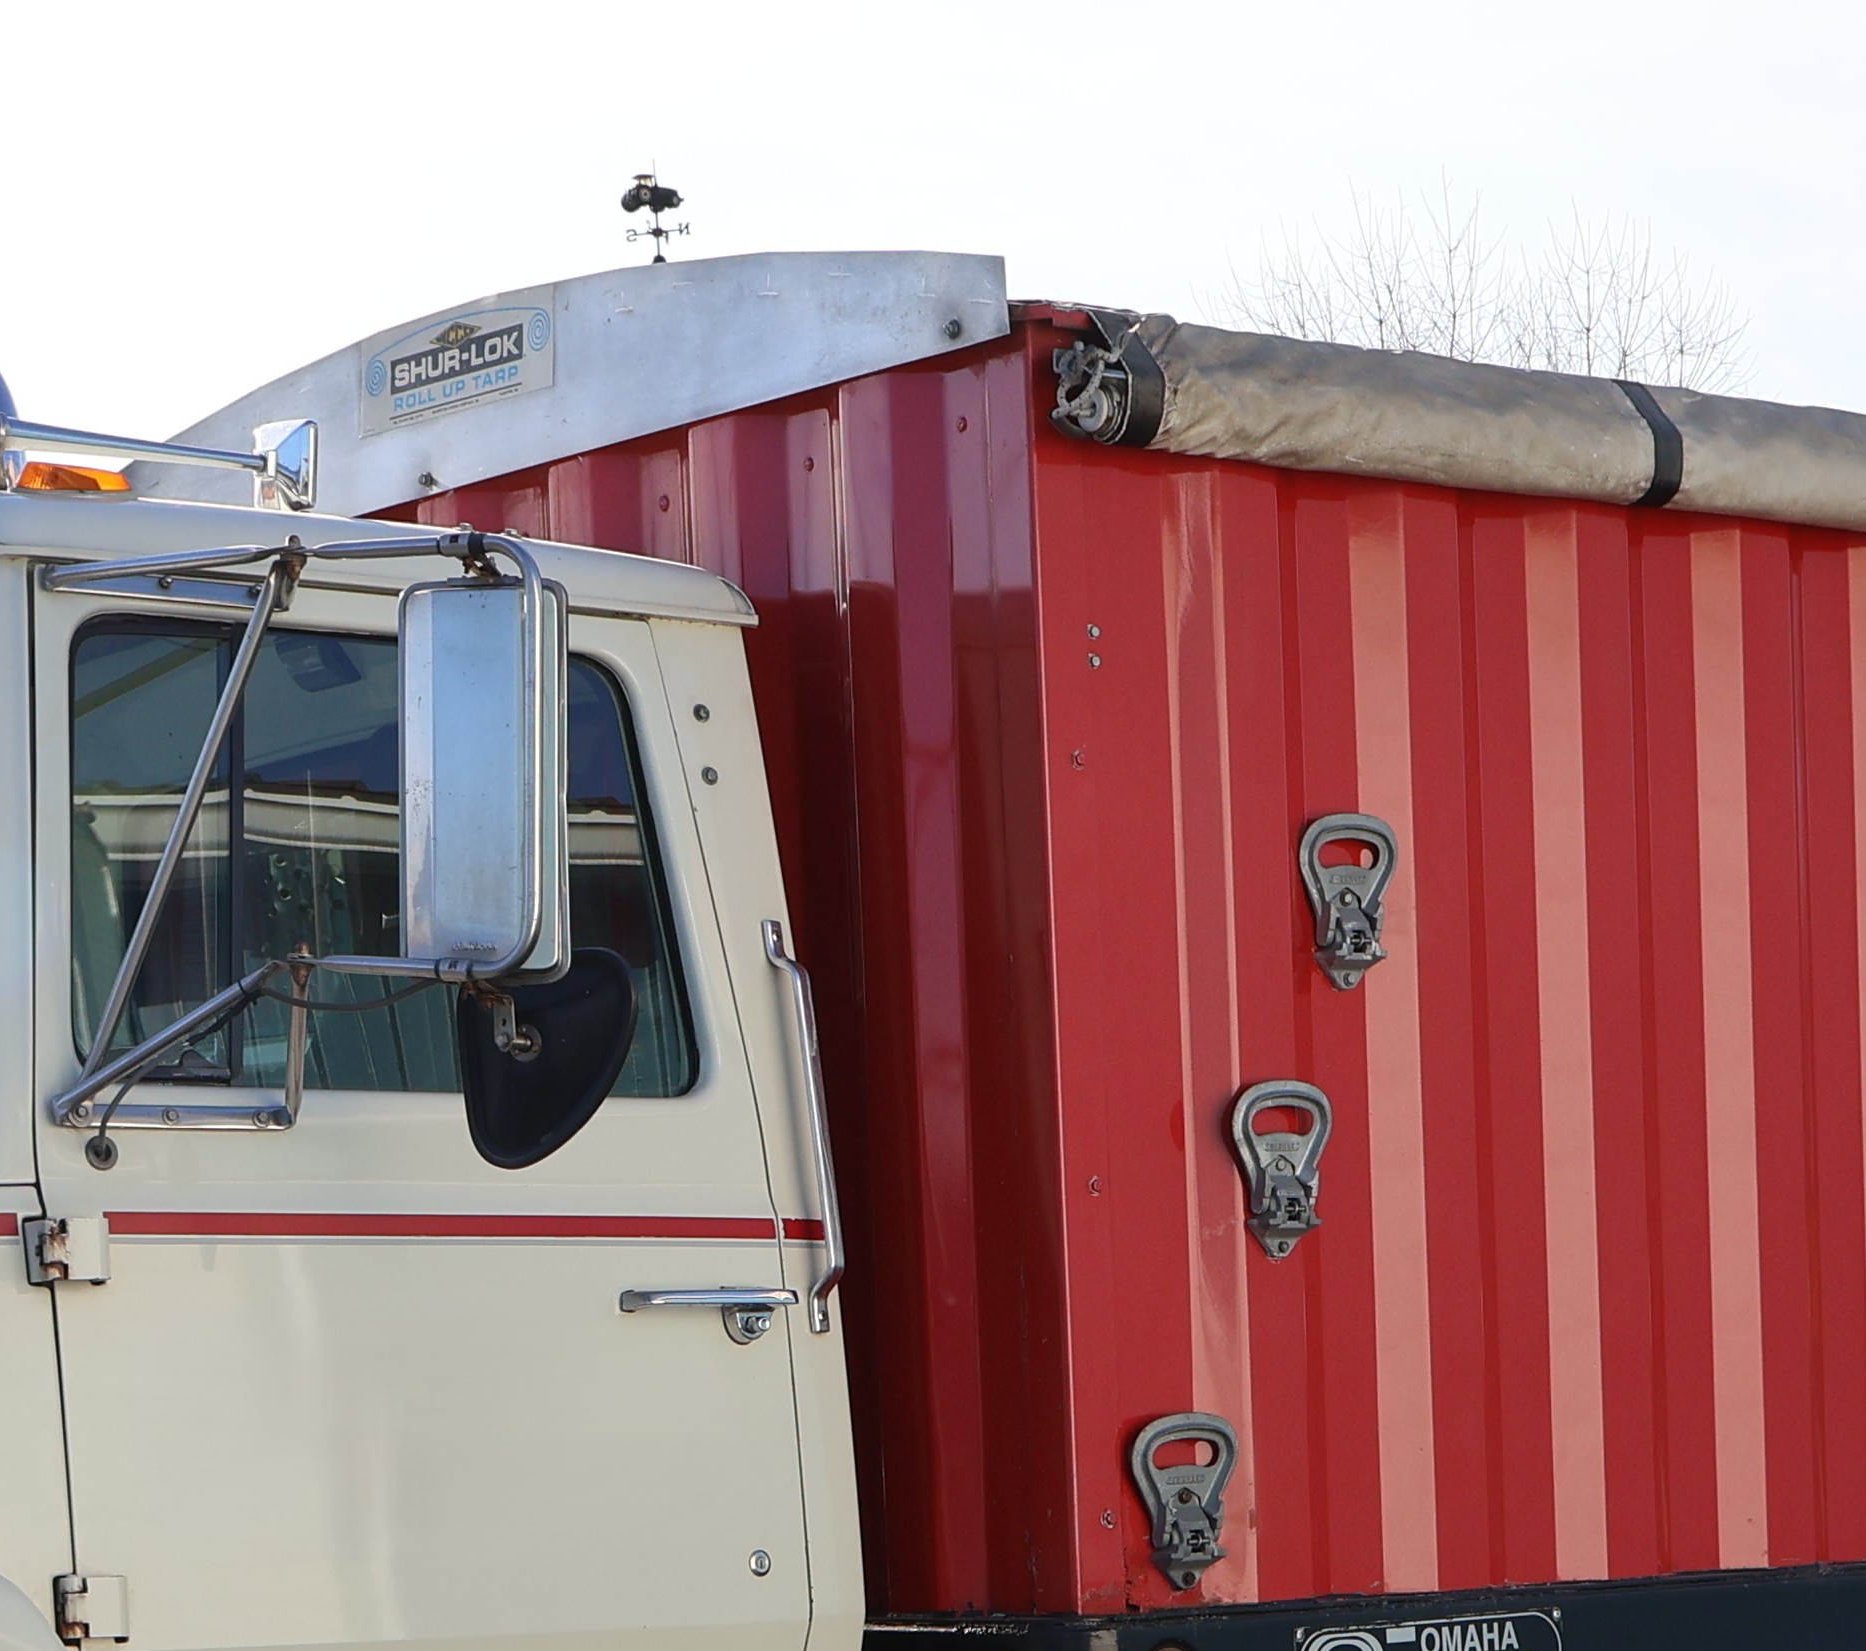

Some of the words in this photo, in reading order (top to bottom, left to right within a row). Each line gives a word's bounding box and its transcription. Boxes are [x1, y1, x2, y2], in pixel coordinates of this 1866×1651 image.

[393, 331, 520, 387] SHUR-LOK
[393, 391, 436, 411] ROLL
[442, 381, 465, 398] UP
[472, 365, 519, 388] TARP
